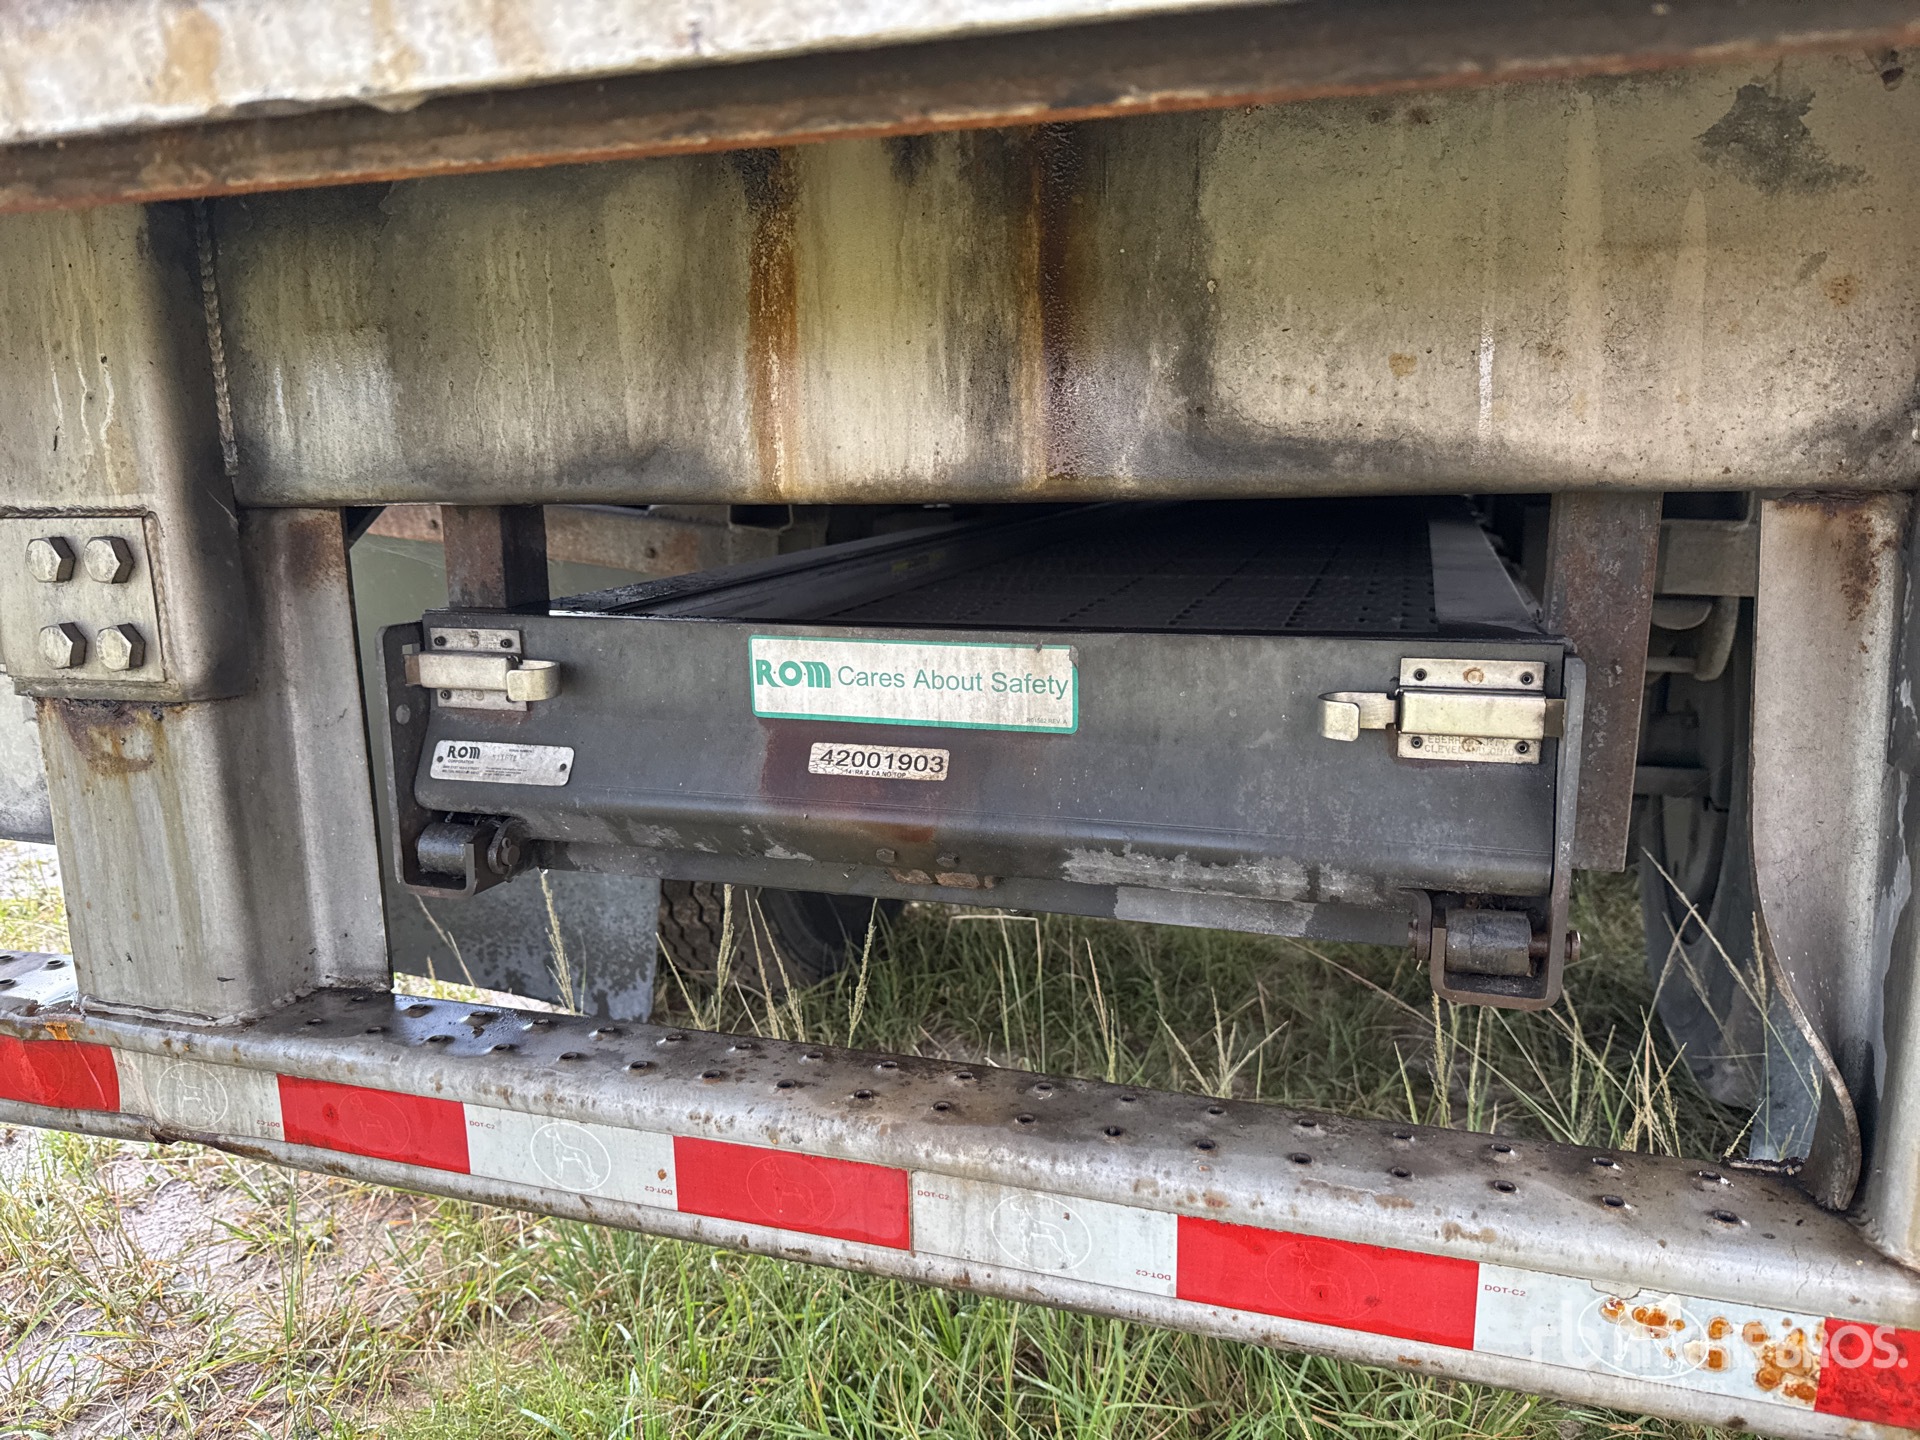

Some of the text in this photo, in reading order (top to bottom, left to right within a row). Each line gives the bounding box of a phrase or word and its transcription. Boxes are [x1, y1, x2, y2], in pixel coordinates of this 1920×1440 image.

[838, 665, 905, 688] Cares
[913, 669, 983, 692] About
[991, 671, 1069, 700] Safety
[819, 749, 944, 773] 42001903
[256, 1119, 280, 1128] DOT-C2
[469, 1120, 495, 1129] DOT-C2
[644, 1185, 673, 1196] DOT-C2
[917, 1189, 950, 1201] DOT-C2
[1135, 1268, 1171, 1281] DOT-C2
[1484, 1284, 1526, 1297] DOT-C2
